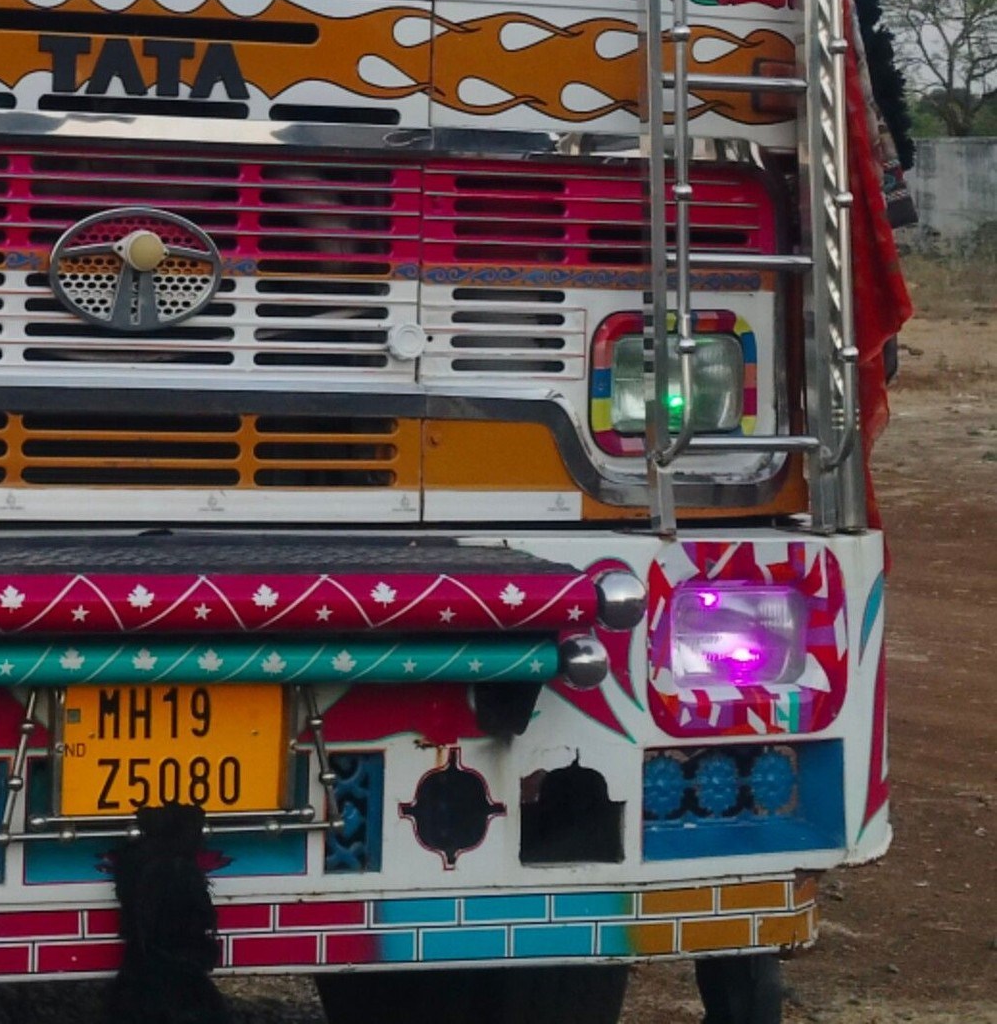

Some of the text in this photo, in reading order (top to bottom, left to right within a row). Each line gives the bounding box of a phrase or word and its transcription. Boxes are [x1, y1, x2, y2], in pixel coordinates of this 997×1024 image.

[38, 35, 250, 100] TATA
[98, 686, 211, 740] MH19
[63, 742, 87, 758] ND
[97, 756, 241, 810] Z5080
